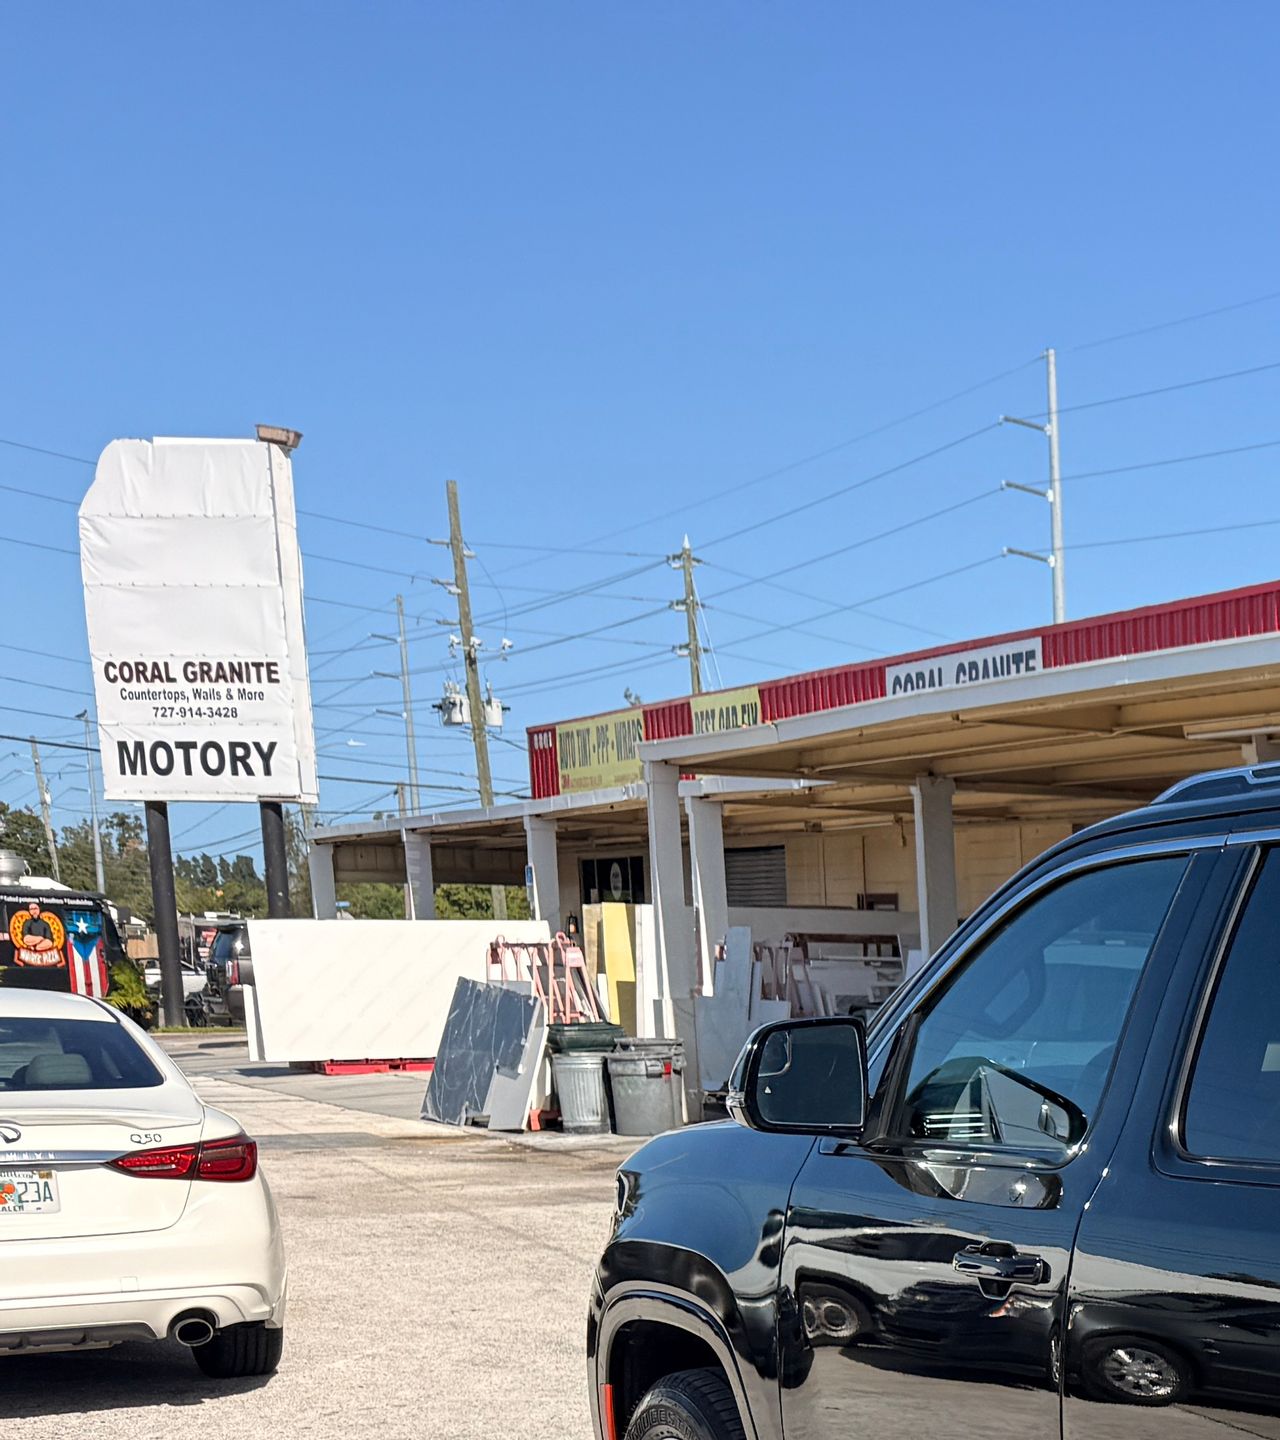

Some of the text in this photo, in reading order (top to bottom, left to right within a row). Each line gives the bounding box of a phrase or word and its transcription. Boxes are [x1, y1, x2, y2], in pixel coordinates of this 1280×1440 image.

[104, 661, 280, 684] CORAL GRANITE
[120, 688, 264, 703] Countertops, Walls & More
[152, 706, 238, 718] 727-914-3428
[117, 740, 278, 777] MOTORY
[130, 1133, 162, 1144] Q50
